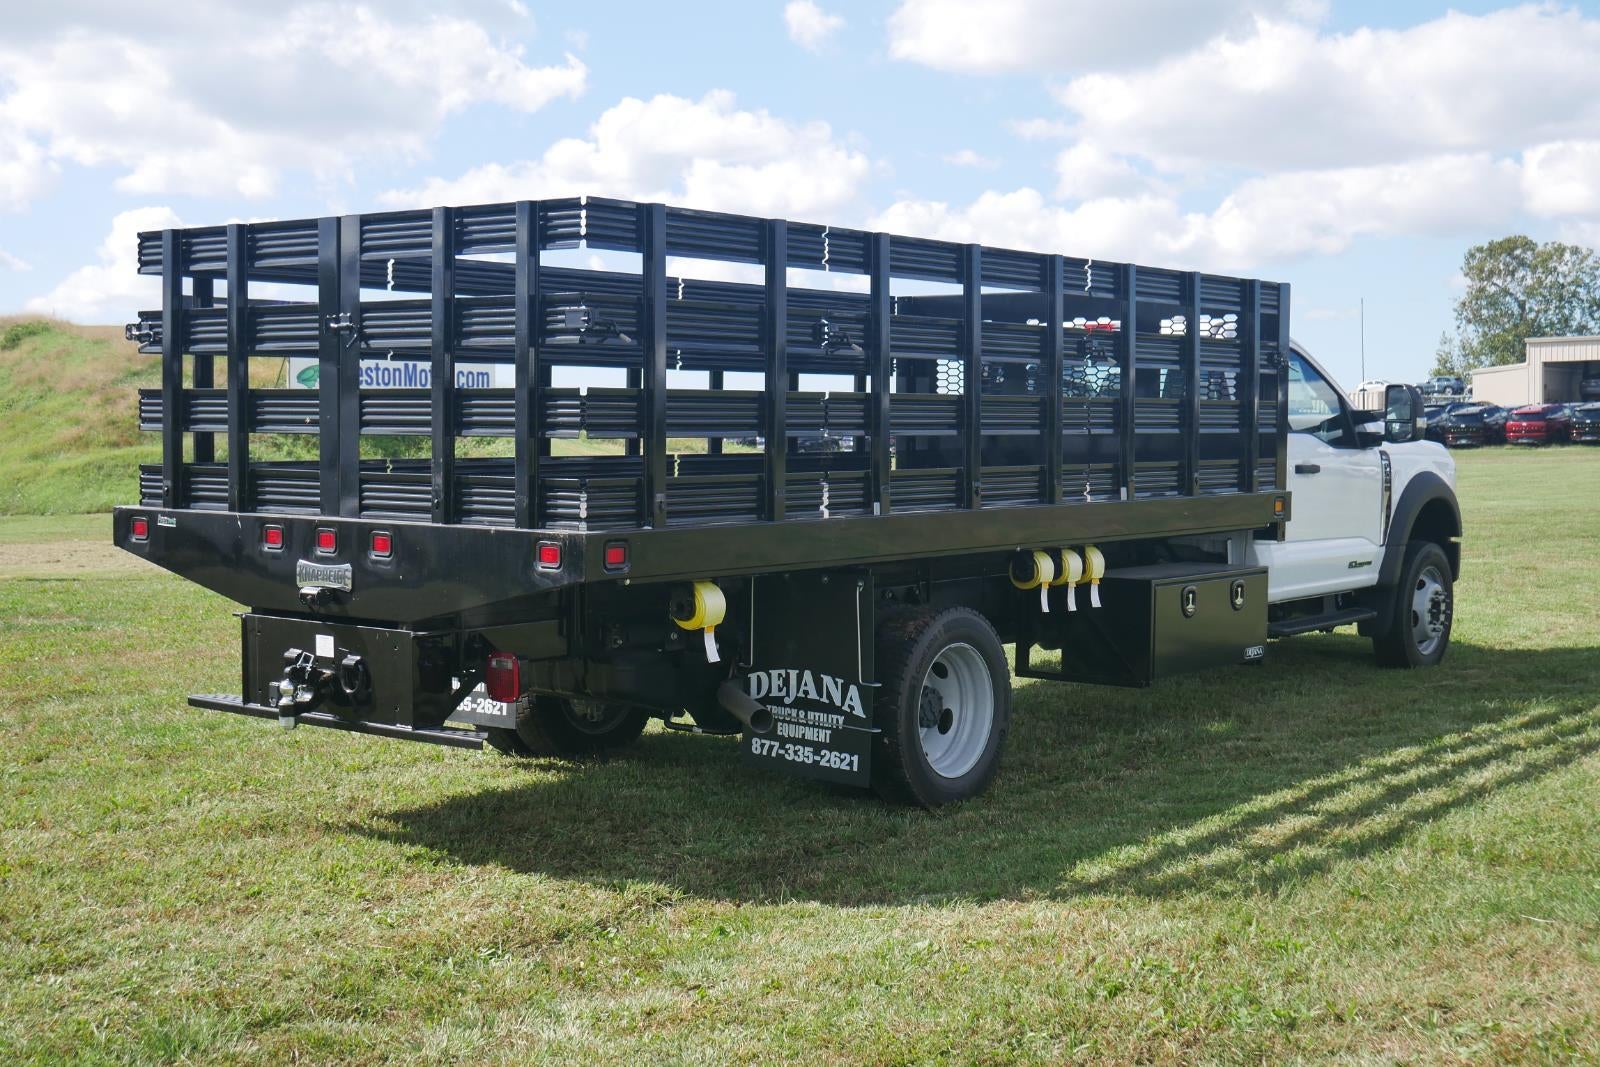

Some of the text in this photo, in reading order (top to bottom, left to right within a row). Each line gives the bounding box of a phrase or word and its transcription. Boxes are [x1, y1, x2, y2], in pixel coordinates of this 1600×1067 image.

[748, 669, 866, 718] DEJANA
[766, 705, 845, 729] TRUCK & UTILITY
[777, 722, 832, 743] EQUIPMENT
[751, 737, 859, 772] 877-335-2621
